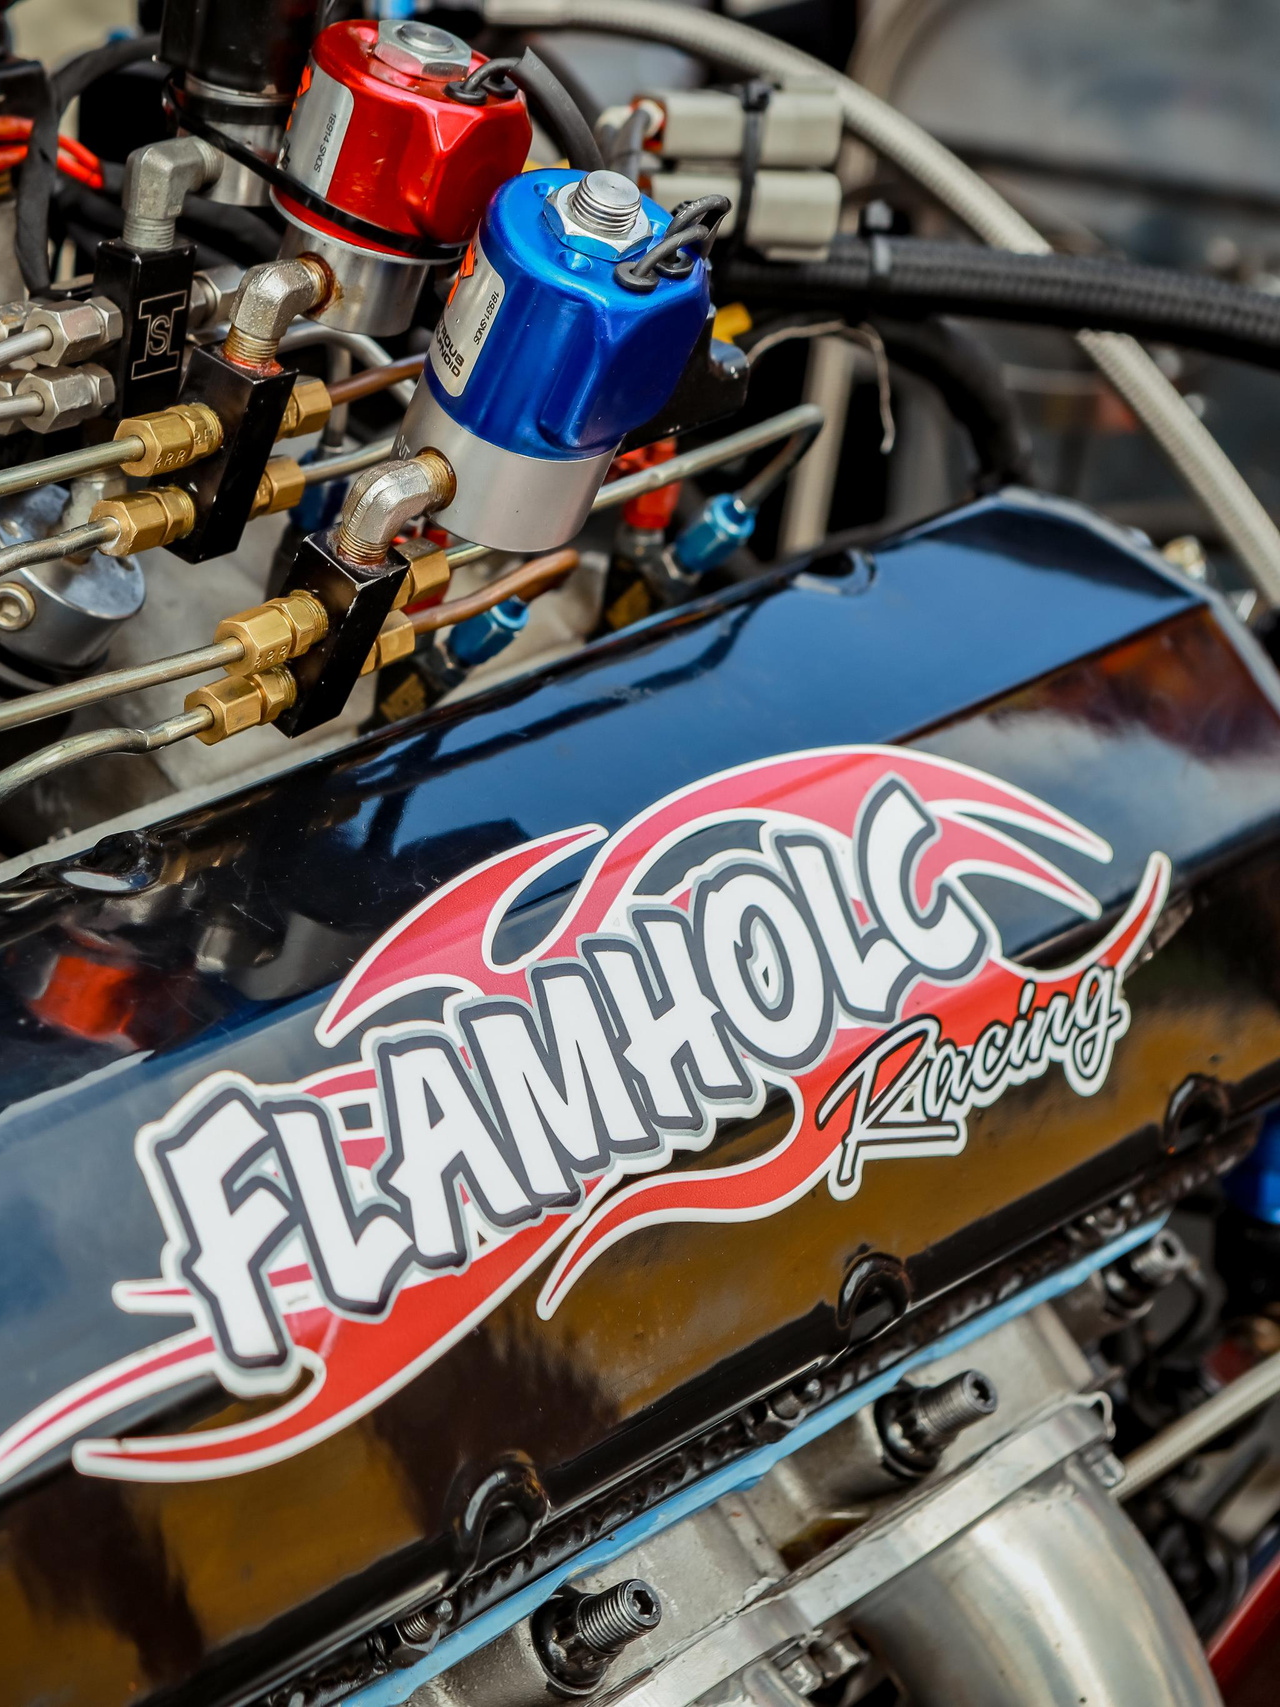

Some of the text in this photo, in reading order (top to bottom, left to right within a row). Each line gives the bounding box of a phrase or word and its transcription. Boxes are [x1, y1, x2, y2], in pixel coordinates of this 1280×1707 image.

[313, 112, 337, 173] 18914-SNOS
[473, 290, 500, 346] 18931-SNOS
[153, 778, 989, 1370] FLAMHOLC
[815, 964, 1123, 1187] Racing
